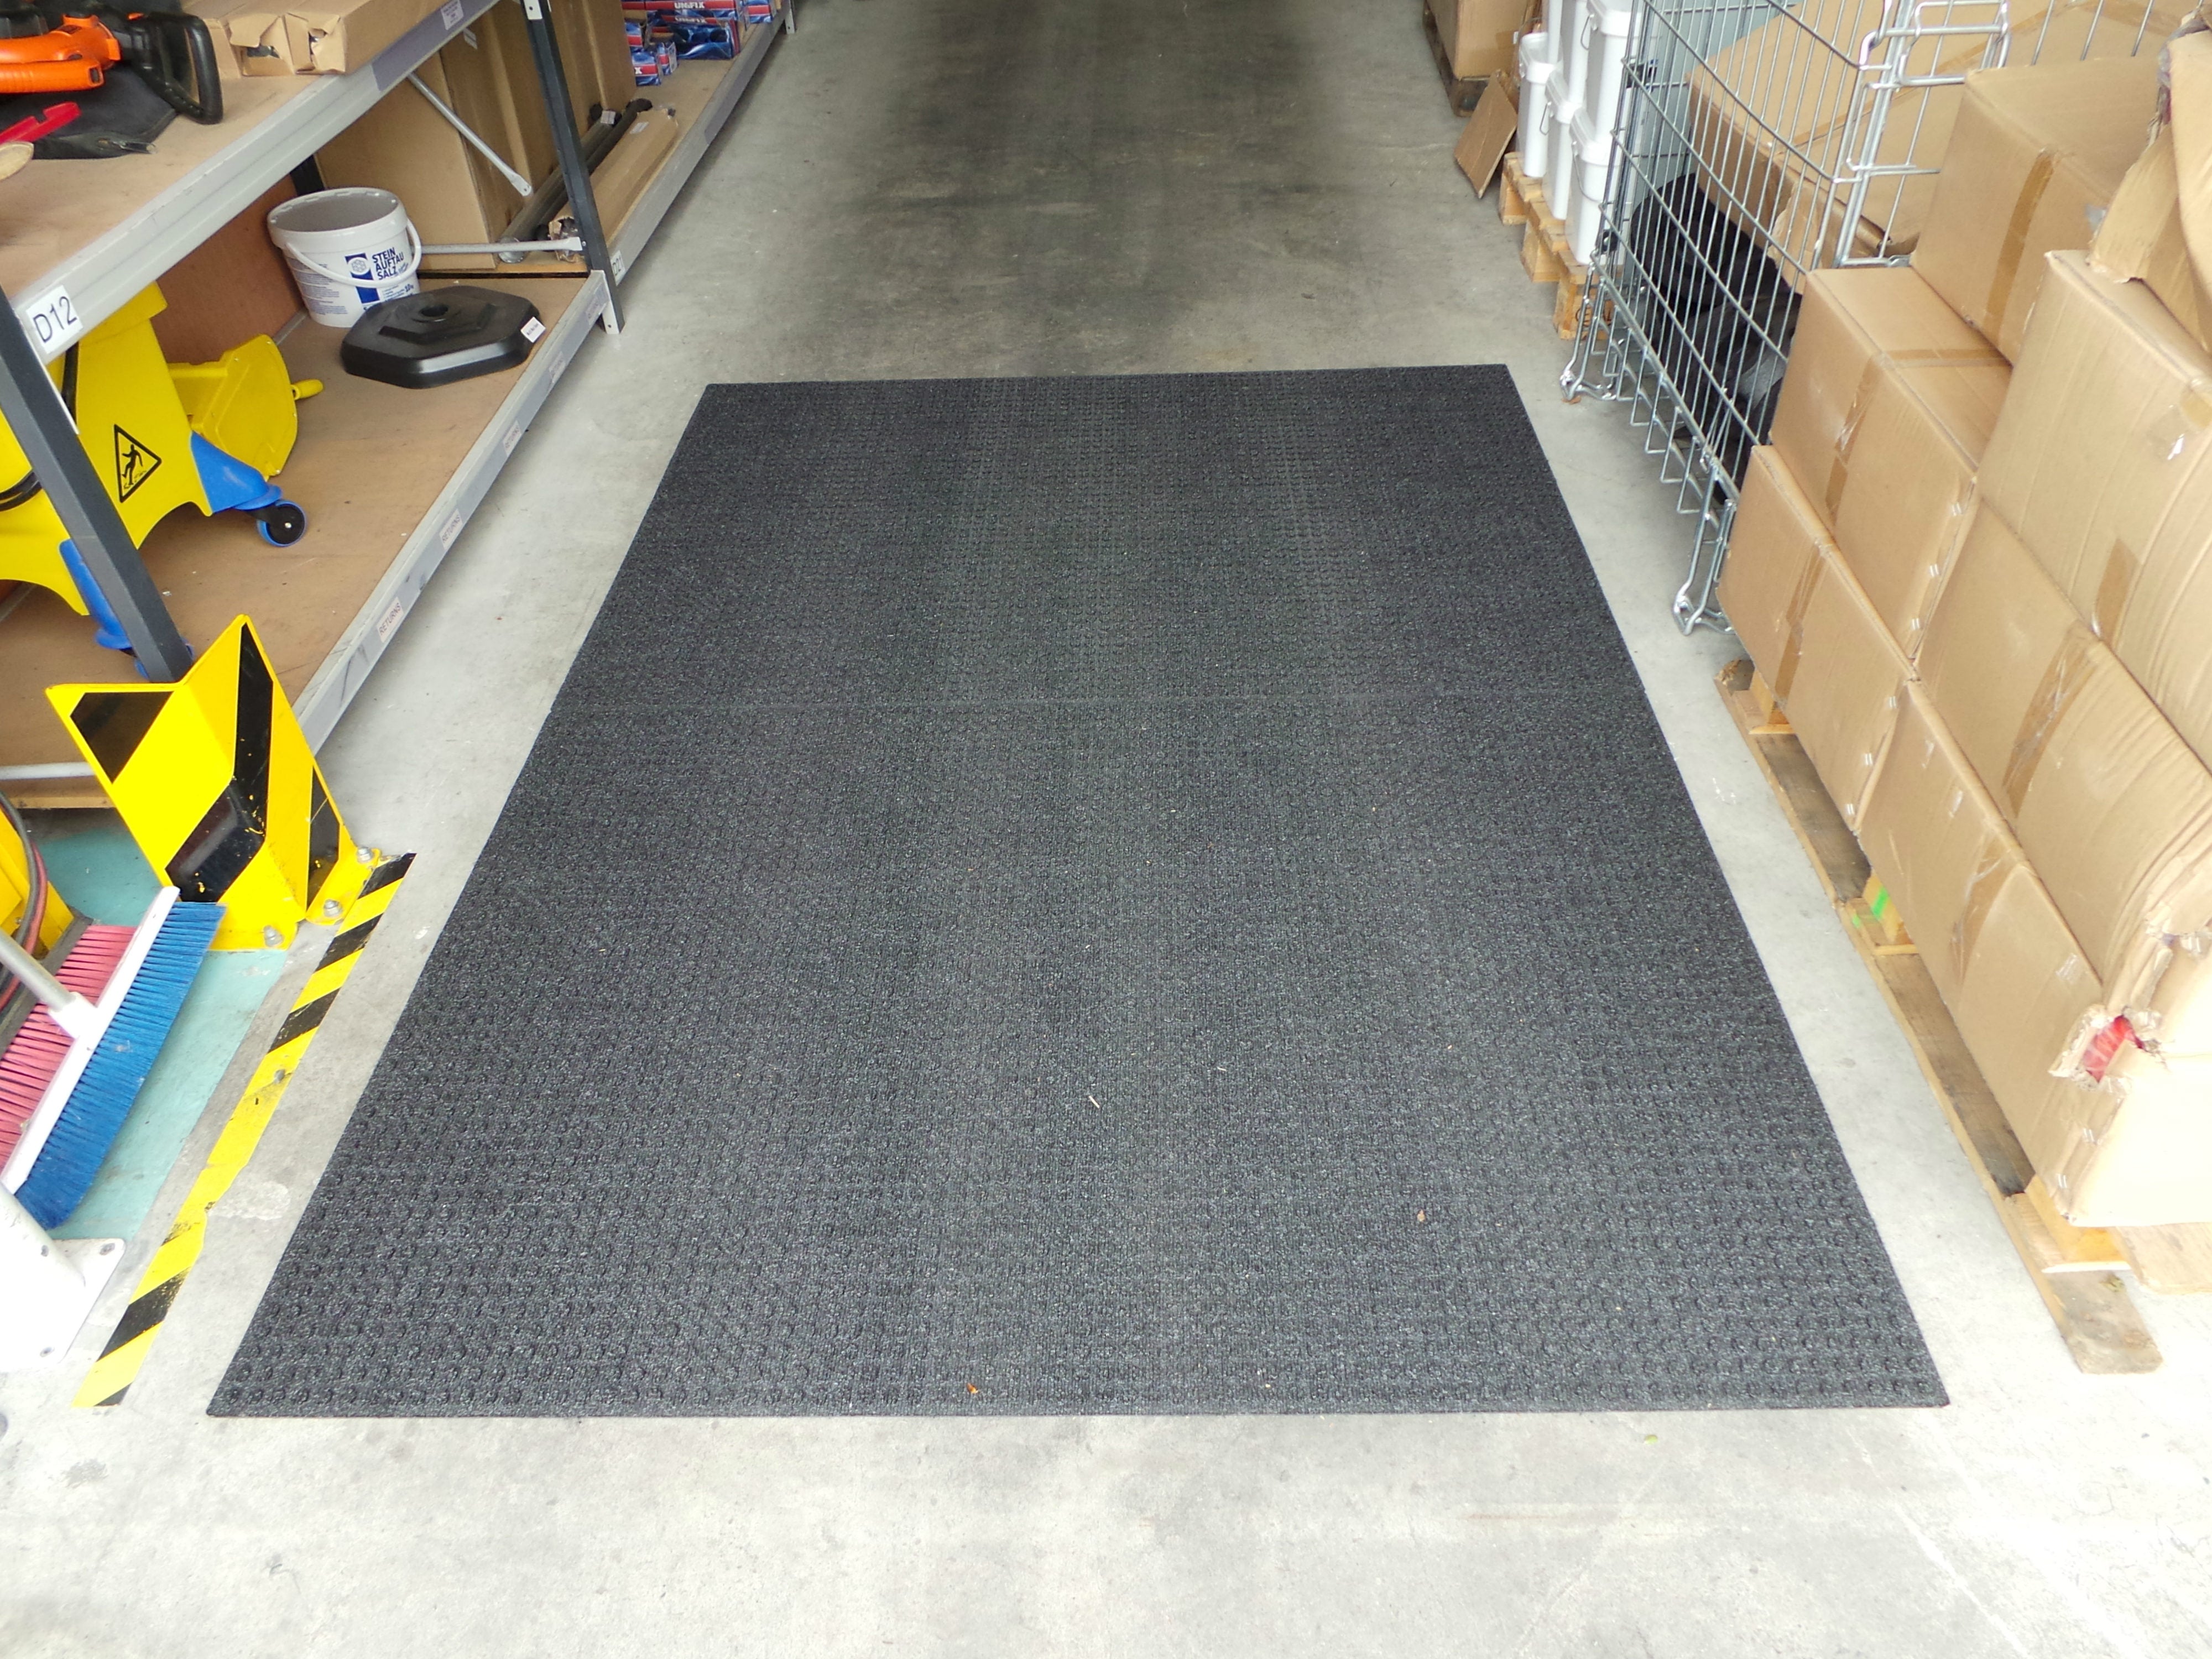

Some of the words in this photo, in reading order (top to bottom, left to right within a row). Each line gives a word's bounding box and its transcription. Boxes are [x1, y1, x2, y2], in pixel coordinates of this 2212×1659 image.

[372, 247, 397, 263] STEIN
[375, 252, 404, 272] AUFTAU
[377, 266, 398, 280] SALZ
[33, 296, 77, 343] D12
[378, 602, 401, 636] RETURNS
